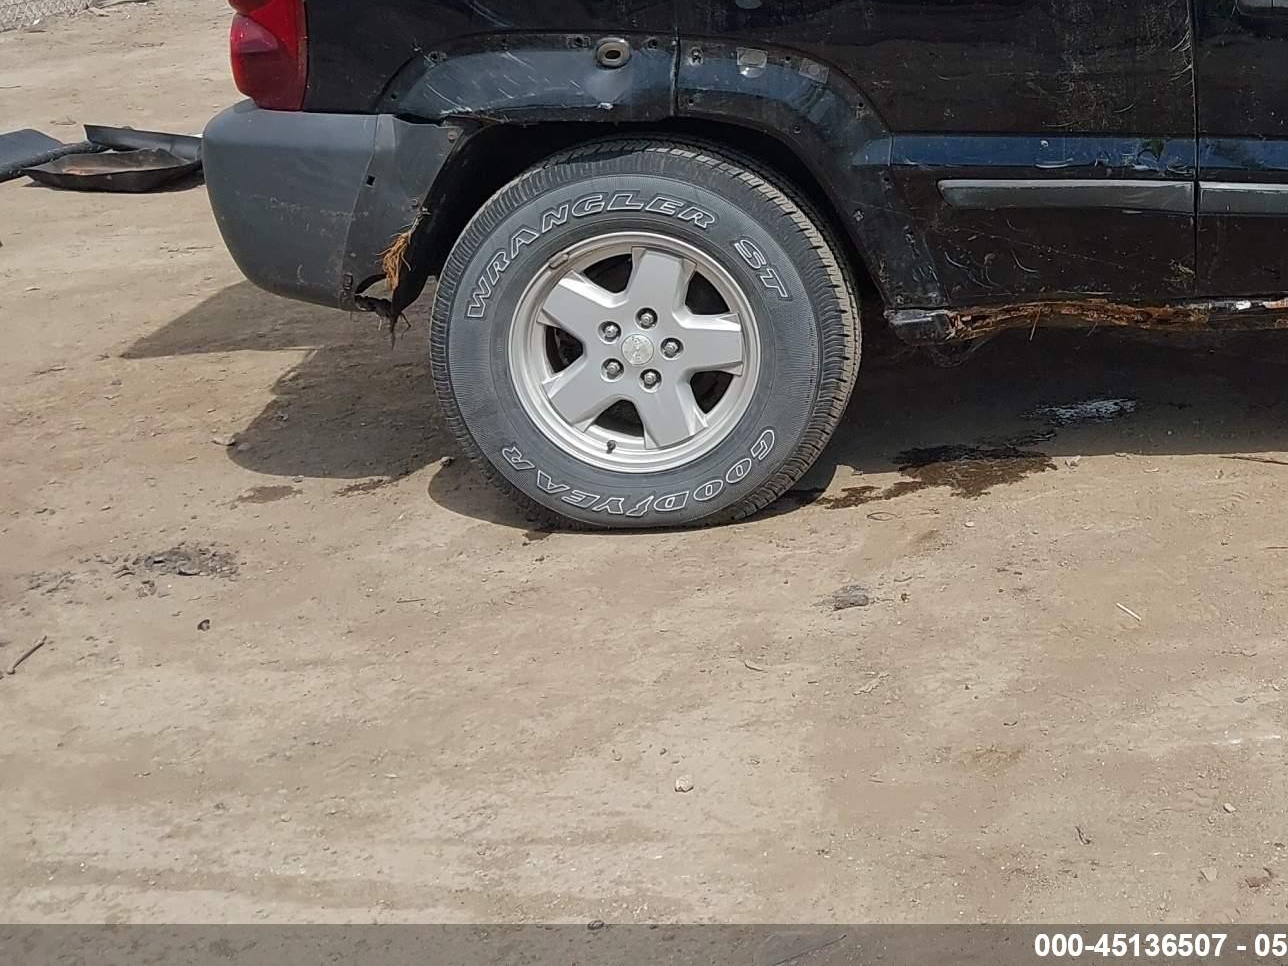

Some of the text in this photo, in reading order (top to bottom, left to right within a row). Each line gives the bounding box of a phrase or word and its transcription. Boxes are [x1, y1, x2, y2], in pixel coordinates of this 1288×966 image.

[466, 189, 790, 320] WRANGLER ST
[501, 429, 776, 518] GOODYEAR
